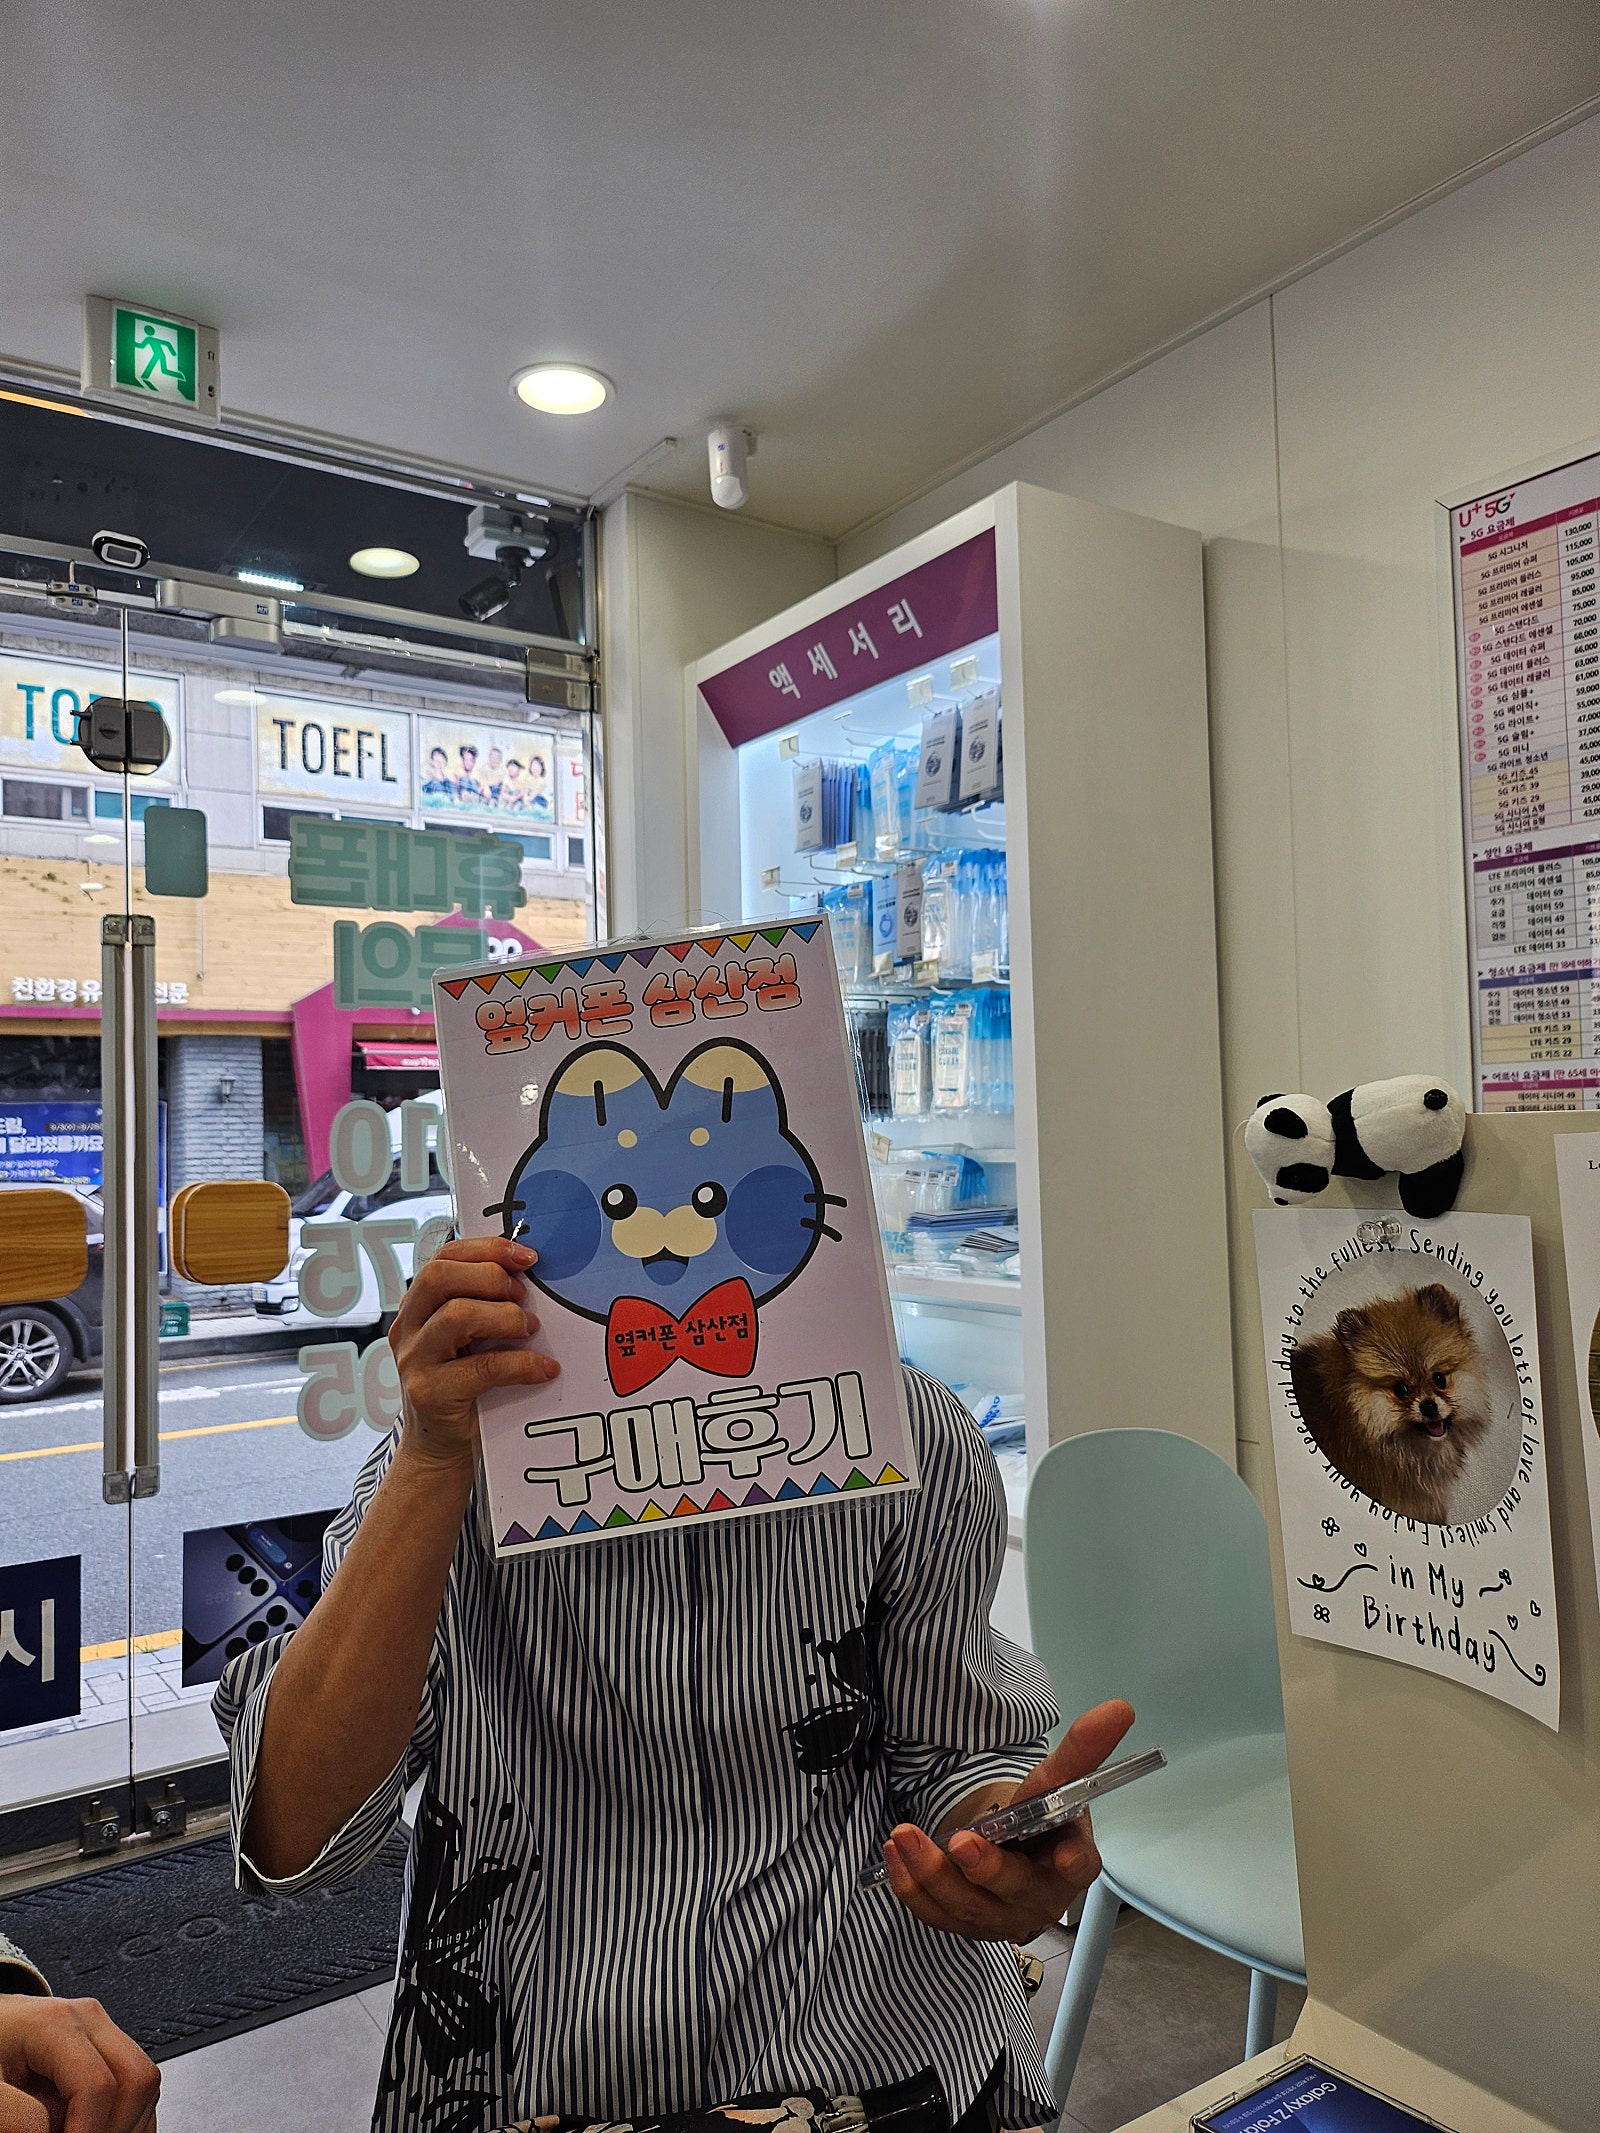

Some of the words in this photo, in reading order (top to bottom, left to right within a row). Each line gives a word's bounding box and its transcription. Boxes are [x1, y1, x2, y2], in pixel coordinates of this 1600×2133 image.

[1485, 496, 1512, 518] 5G
[1471, 528, 1484, 540] 5G
[1487, 516, 1515, 533] 요금제
[1564, 522, 1592, 536] 130,000
[1488, 552, 1498, 561] 5G
[1500, 540, 1528, 556] 시그니처
[1565, 537, 1593, 552] 115,000
[1481, 570, 1490, 580] 5G
[1493, 560, 1520, 576] 프리미어
[1523, 554, 1537, 566] 슈퍼
[1566, 552, 1594, 567] 105,000
[1478, 587, 1487, 596] 5G
[1490, 577, 1518, 592] 프리미어
[1520, 569, 1542, 583] 플러스
[1571, 567, 1595, 581] 95,000
[1572, 582, 1596, 596] 85,000
[1478, 601, 1488, 610] 5G
[1490, 592, 1518, 606] 프리미어
[1572, 598, 1596, 611] 75,000
[1479, 615, 1488, 625] 5G
[1491, 606, 1519, 621] 프리미어
[1573, 613, 1597, 626] 70,000
[1495, 626, 1505, 636] 5G
[1507, 615, 1539, 629] 스탠다드
[1574, 628, 1598, 640] 68,000
[768, 597, 924, 700] 액세서리
[1482, 643, 1493, 653] 5G
[1491, 655, 1501, 665] 5G
[1503, 646, 1526, 660] 데이터
[1529, 641, 1545, 653] 슈퍼
[1574, 641, 1598, 654] 66,000
[1487, 669, 1497, 679] 5G
[1500, 662, 1523, 675] 데이터
[1526, 655, 1550, 669] 플러스
[1575, 655, 1599, 668] 63,000
[1488, 683, 1498, 693] 5G
[1500, 676, 1524, 689] 데이터
[1527, 668, 1551, 682] 레귤러
[1575, 669, 1599, 682] 61,000
[1497, 694, 1508, 704] 5G
[1576, 683, 1600, 696] 59,000
[1577, 697, 1600, 709] 55,000
[1493, 708, 1504, 718] 5G
[1494, 722, 1505, 732] 5G
[1497, 735, 1509, 745] 5G
[272, 717, 398, 783] TOEFL
[1498, 748, 1509, 758] 5G
[1512, 742, 1529, 754] 미니
[1487, 763, 1497, 773] 5G
[1500, 757, 1522, 770] 라이트
[1526, 751, 1548, 764] 청소년
[1497, 772, 1507, 782] 5G
[1498, 787, 1508, 797] 5G
[1499, 799, 1509, 809] 5G
[1494, 811, 1504, 821] 5G
[1495, 823, 1505, 833] 5G
[1484, 845, 1501, 859] 성인
[1505, 841, 1533, 854] 요금제
[1488, 966, 1515, 977] 청소년
[1518, 962, 1546, 973] 요금제
[474, 978, 635, 1056] 옆커폰
[642, 952, 803, 1028] 삼산점
[1492, 1071, 1519, 1082] 어르신
[1522, 1069, 1551, 1080] 요금제
[1587, 1160, 1600, 1170] L
[1409, 1229, 1484, 1288] Sending
[1299, 1267, 1328, 1299] the
[1285, 1304, 1304, 1326] to
[1484, 1288, 1514, 1327] you
[612, 1318, 678, 1358] 옆커폰
[684, 1311, 750, 1346] 삼산점
[1271, 1333, 1299, 1370] day
[1508, 1333, 1533, 1385] lots
[1277, 1381, 1319, 1454] special
[1521, 1396, 1538, 1426] of
[523, 1370, 872, 1507] 구매후기
[1518, 1434, 1540, 1484] love
[1322, 1462, 1363, 1502] your
[1497, 1487, 1522, 1532] and
[1368, 1498, 1430, 1546] Enjoy
[1440, 1513, 1497, 1549] smiles!
[1388, 1554, 1415, 1590] in
[1428, 1561, 1464, 1608] My
[1362, 1594, 1496, 1673] Birthday
[1284, 2081, 1338, 2111] Galaxy
[1238, 2114, 1283, 2133] Fold
[1274, 2107, 1292, 2121] Z
